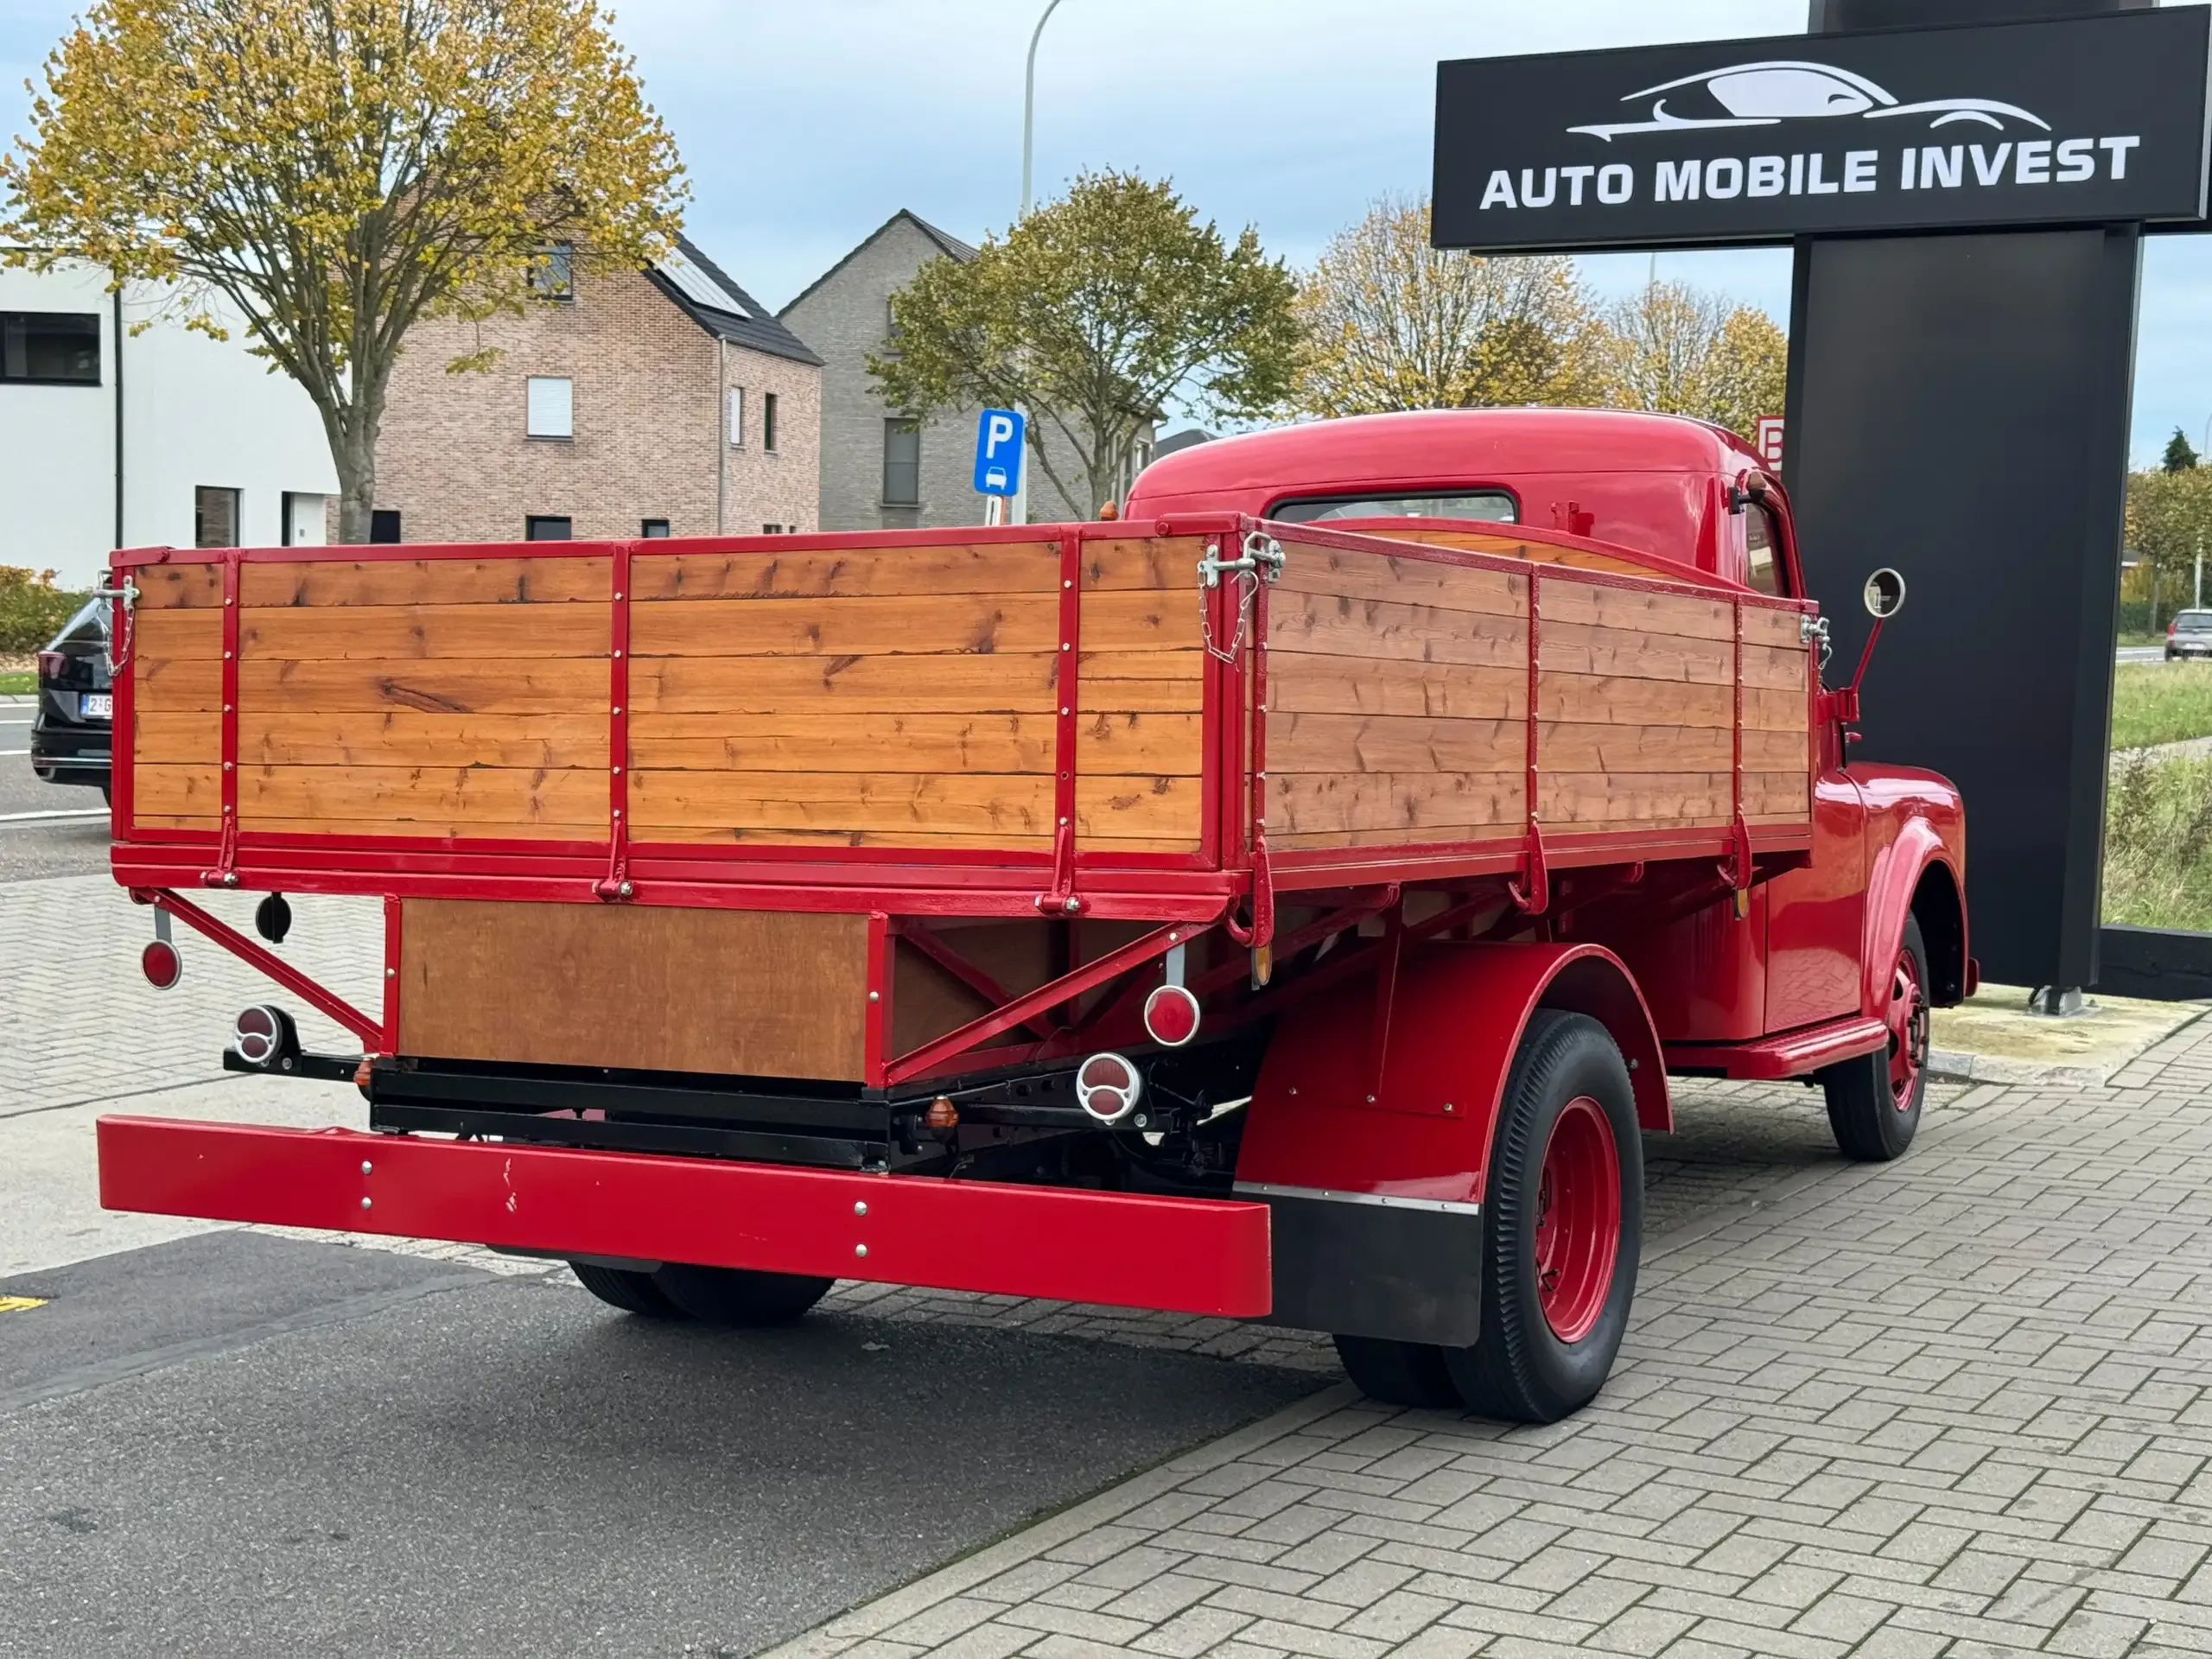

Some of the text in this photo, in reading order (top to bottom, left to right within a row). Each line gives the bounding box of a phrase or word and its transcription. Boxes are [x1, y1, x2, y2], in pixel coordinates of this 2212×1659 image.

[1478, 135, 2140, 210] AUTO MOBILE INVEST
[986, 415, 1014, 459] P
